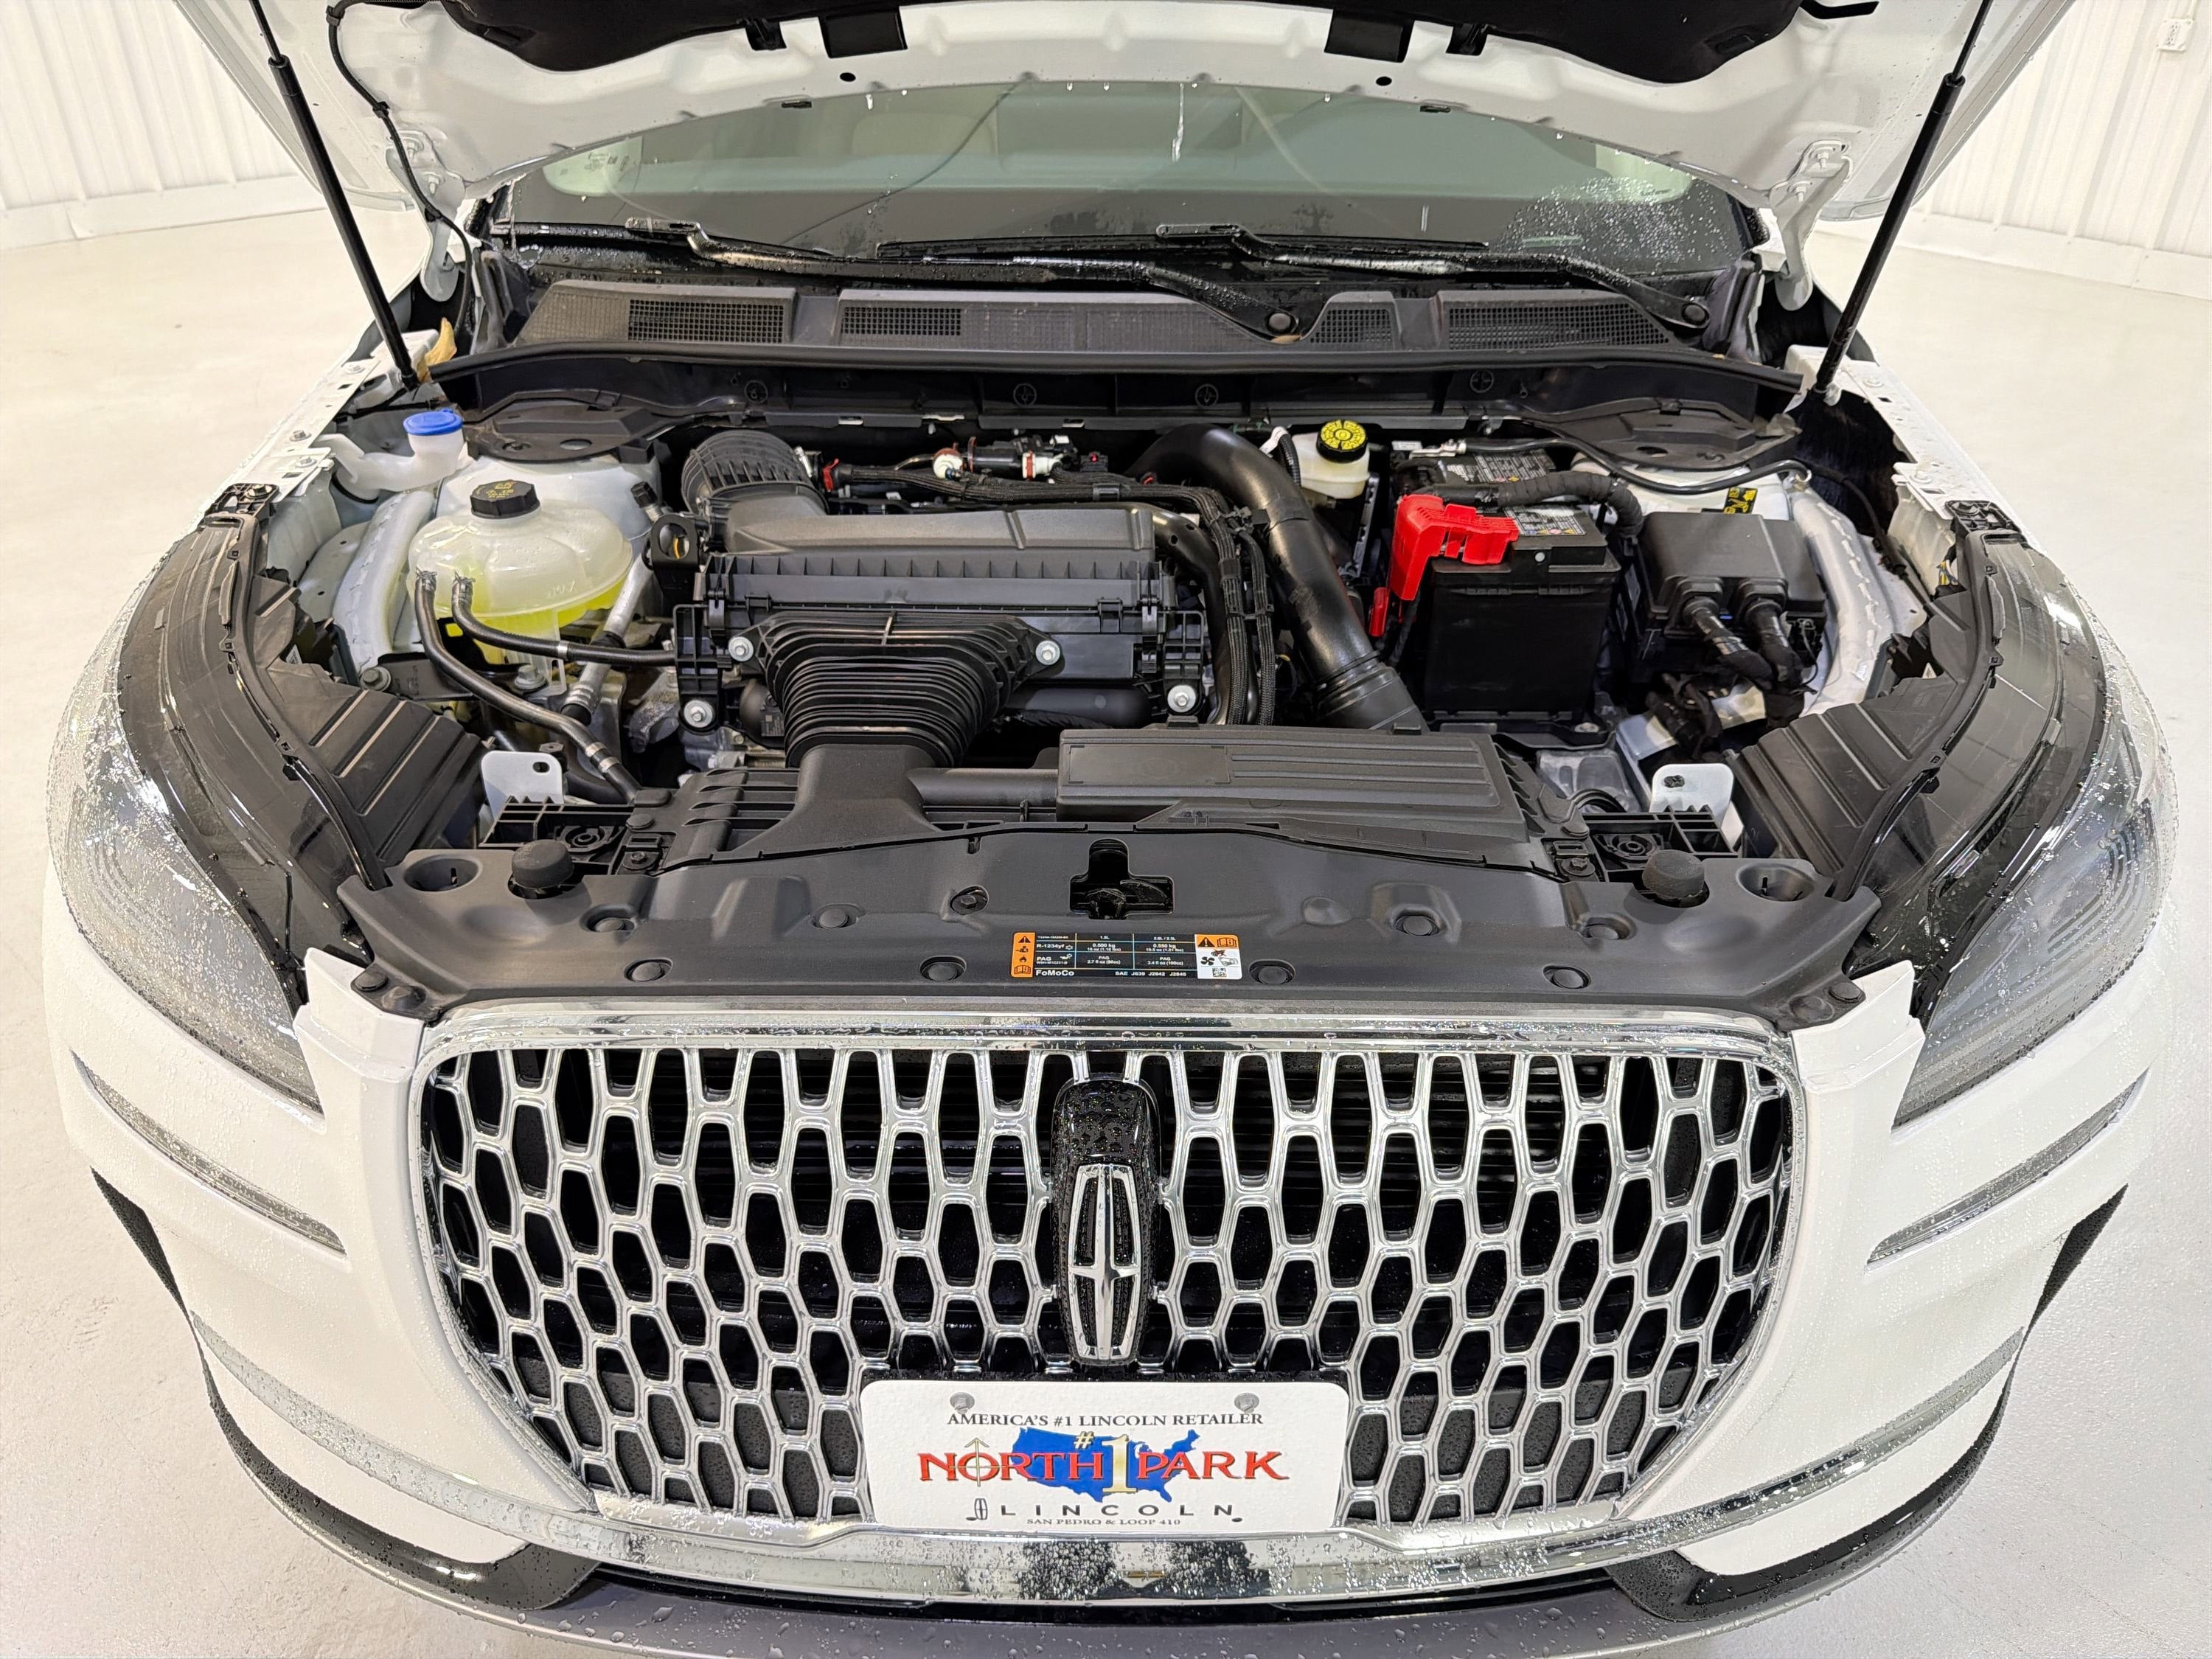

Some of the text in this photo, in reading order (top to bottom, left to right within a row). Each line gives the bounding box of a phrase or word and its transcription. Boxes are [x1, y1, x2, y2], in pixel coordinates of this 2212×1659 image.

[947, 1413, 1264, 1427] AMERICA'S #1 LINCOLN RETAILER
[917, 1450, 1290, 1482] NORTH PARK
[1001, 1504, 1233, 1516] LINCOLN
